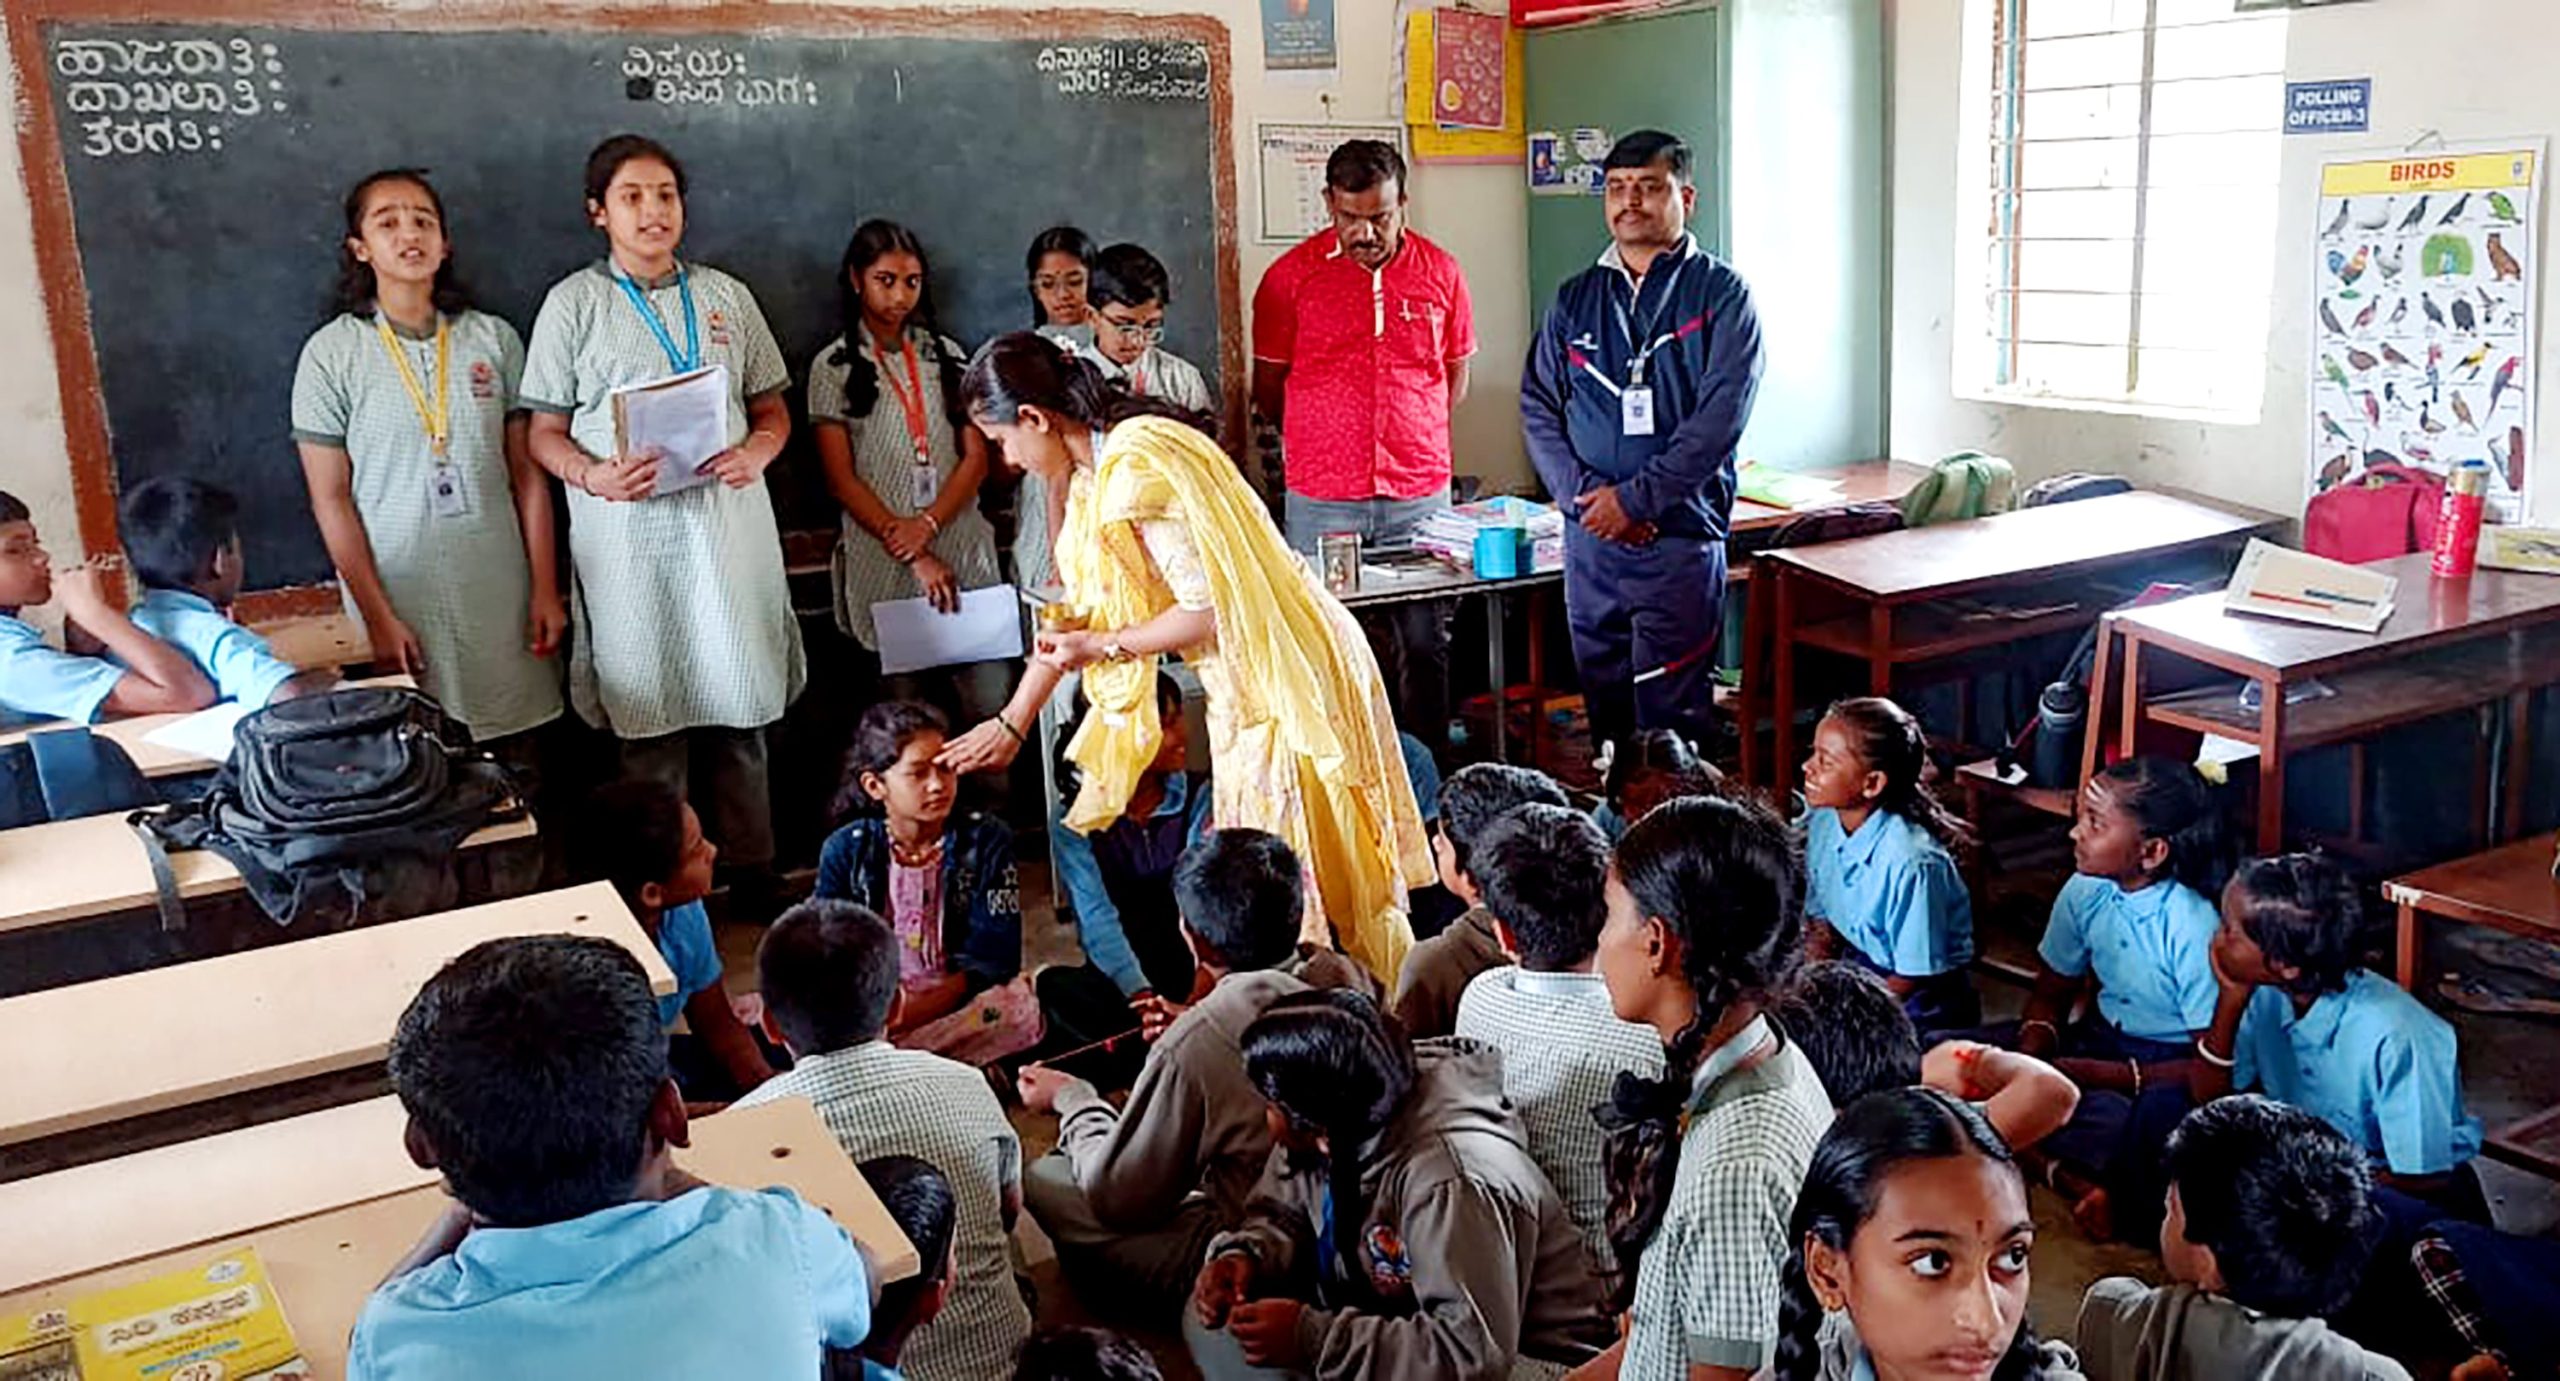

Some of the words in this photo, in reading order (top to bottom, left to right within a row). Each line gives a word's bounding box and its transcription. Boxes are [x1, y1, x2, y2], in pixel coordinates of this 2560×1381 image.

[622, 43, 746, 80] ವಿಷಯ:
[2296, 89, 2362, 106] POLLING
[2390, 161, 2456, 181] BIRDS
